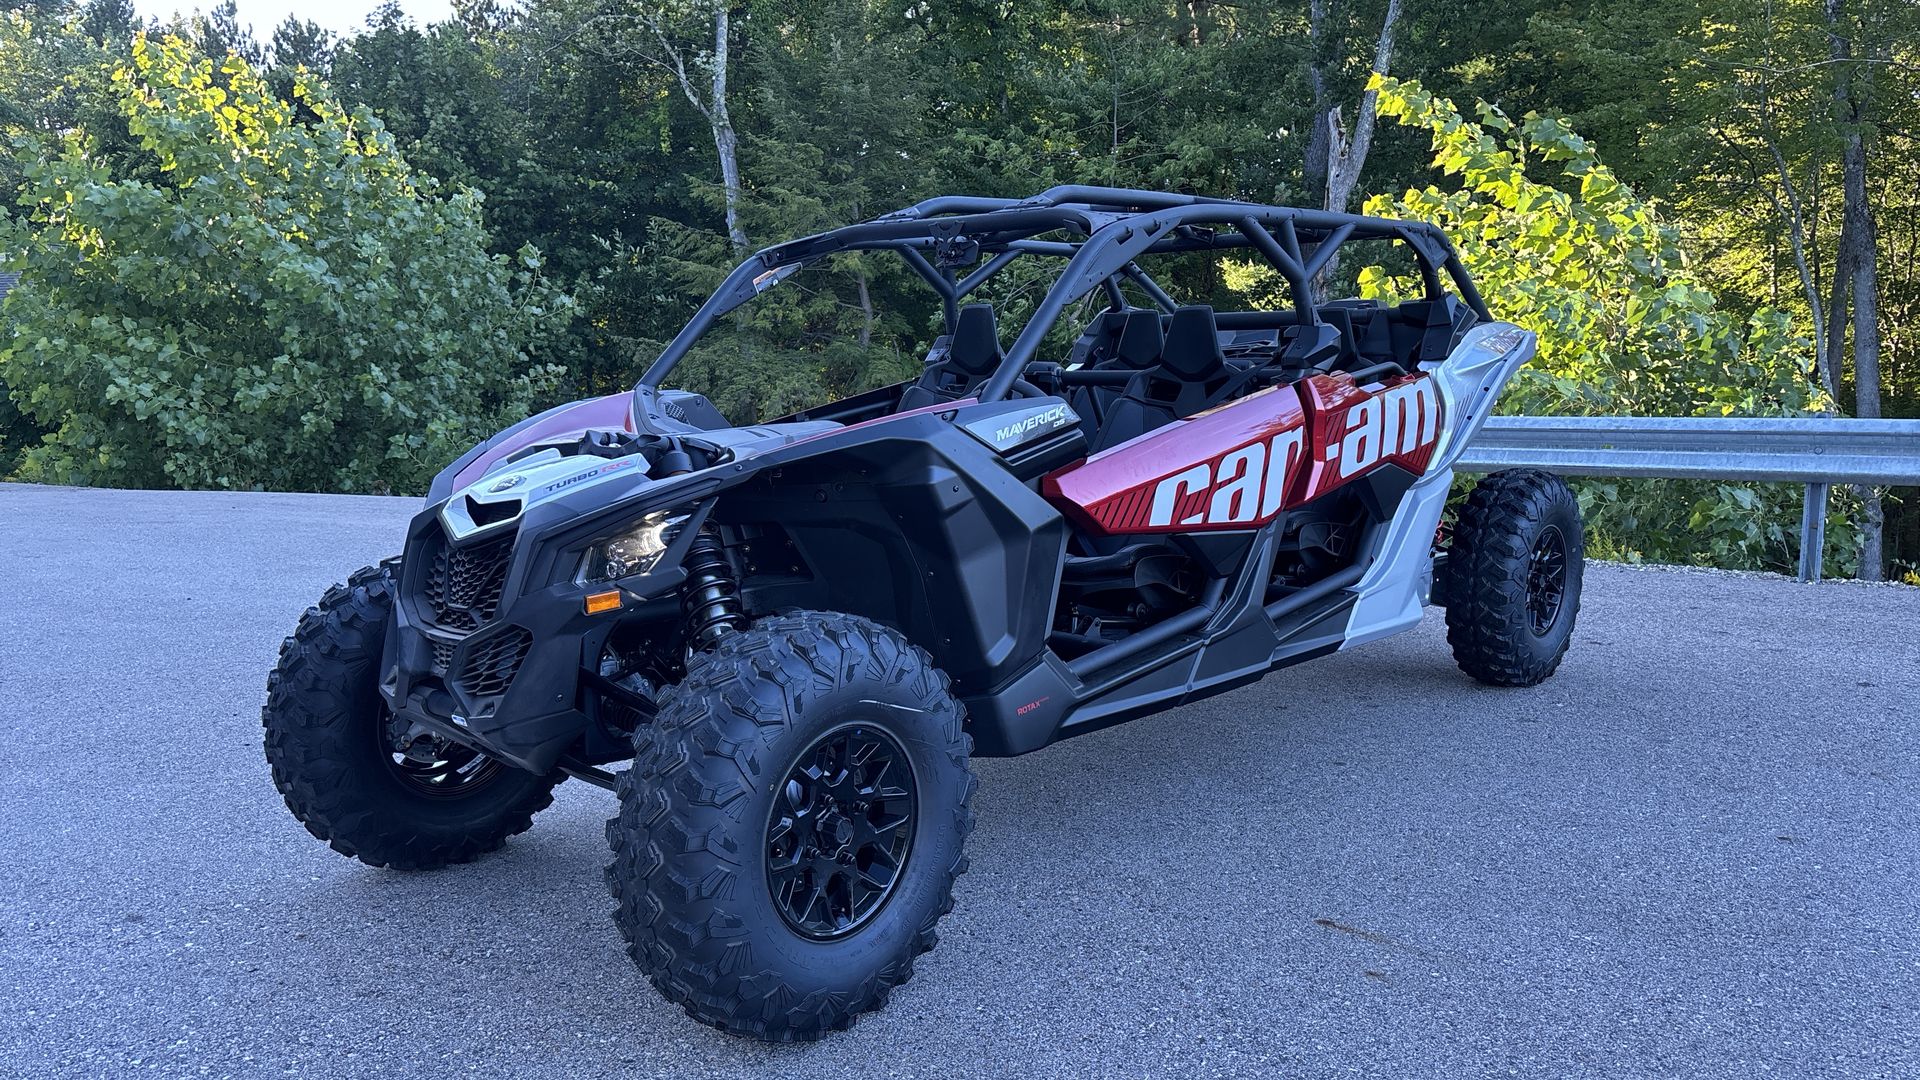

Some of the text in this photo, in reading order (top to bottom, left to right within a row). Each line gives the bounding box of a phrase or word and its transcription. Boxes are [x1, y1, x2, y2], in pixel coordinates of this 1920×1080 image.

[996, 405, 1065, 441] MAVERICK
[546, 469, 598, 492] TURBO
[1017, 700, 1041, 716] ROTAX
